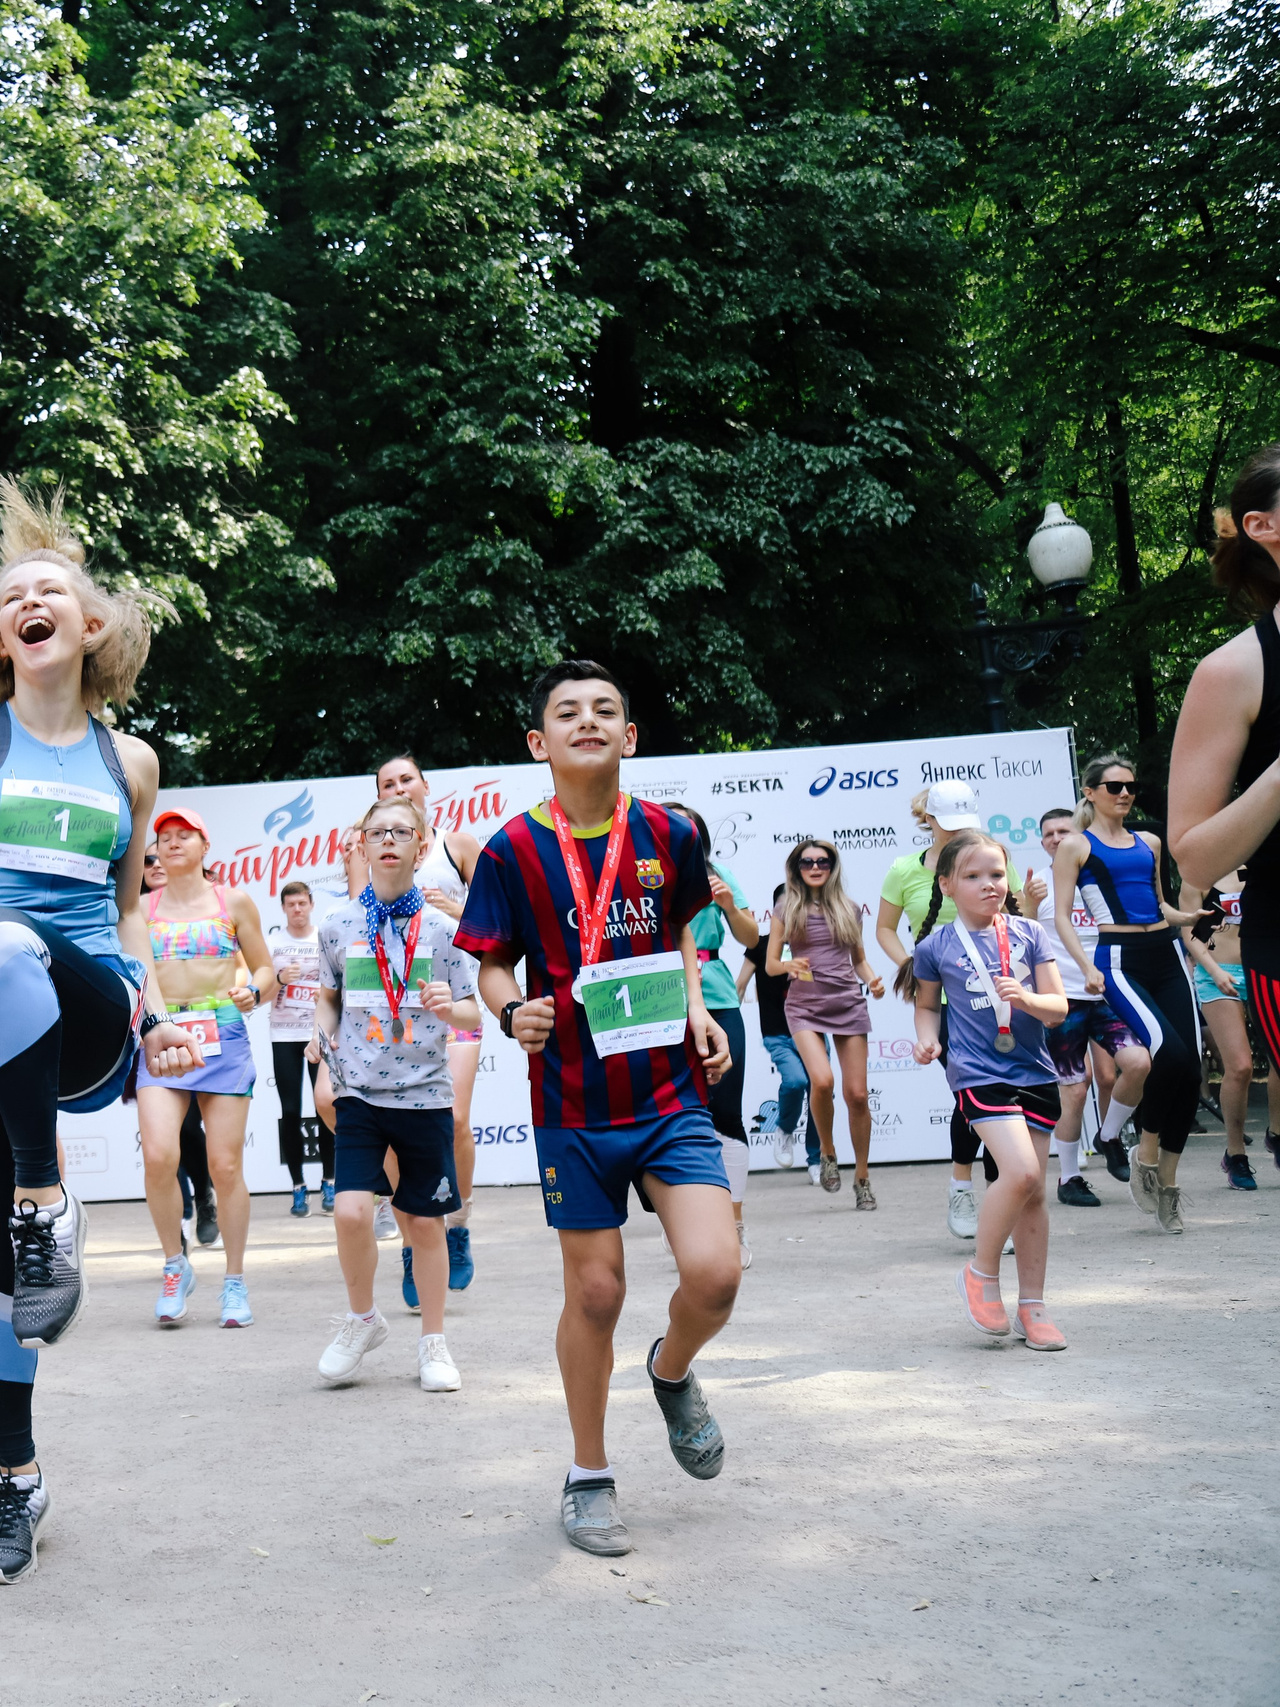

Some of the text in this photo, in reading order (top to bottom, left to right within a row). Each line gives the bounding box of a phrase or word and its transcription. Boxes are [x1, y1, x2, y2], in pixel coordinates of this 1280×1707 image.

[990, 755, 1043, 779] Такси
[710, 777, 784, 796] #SEKTA
[838, 768, 899, 791] asics
[54, 808, 71, 842] 1
[833, 826, 897, 839] MMOMA
[834, 838, 898, 850] MMOMA
[615, 984, 633, 1018] 1
[546, 1191, 562, 1204] FCB
